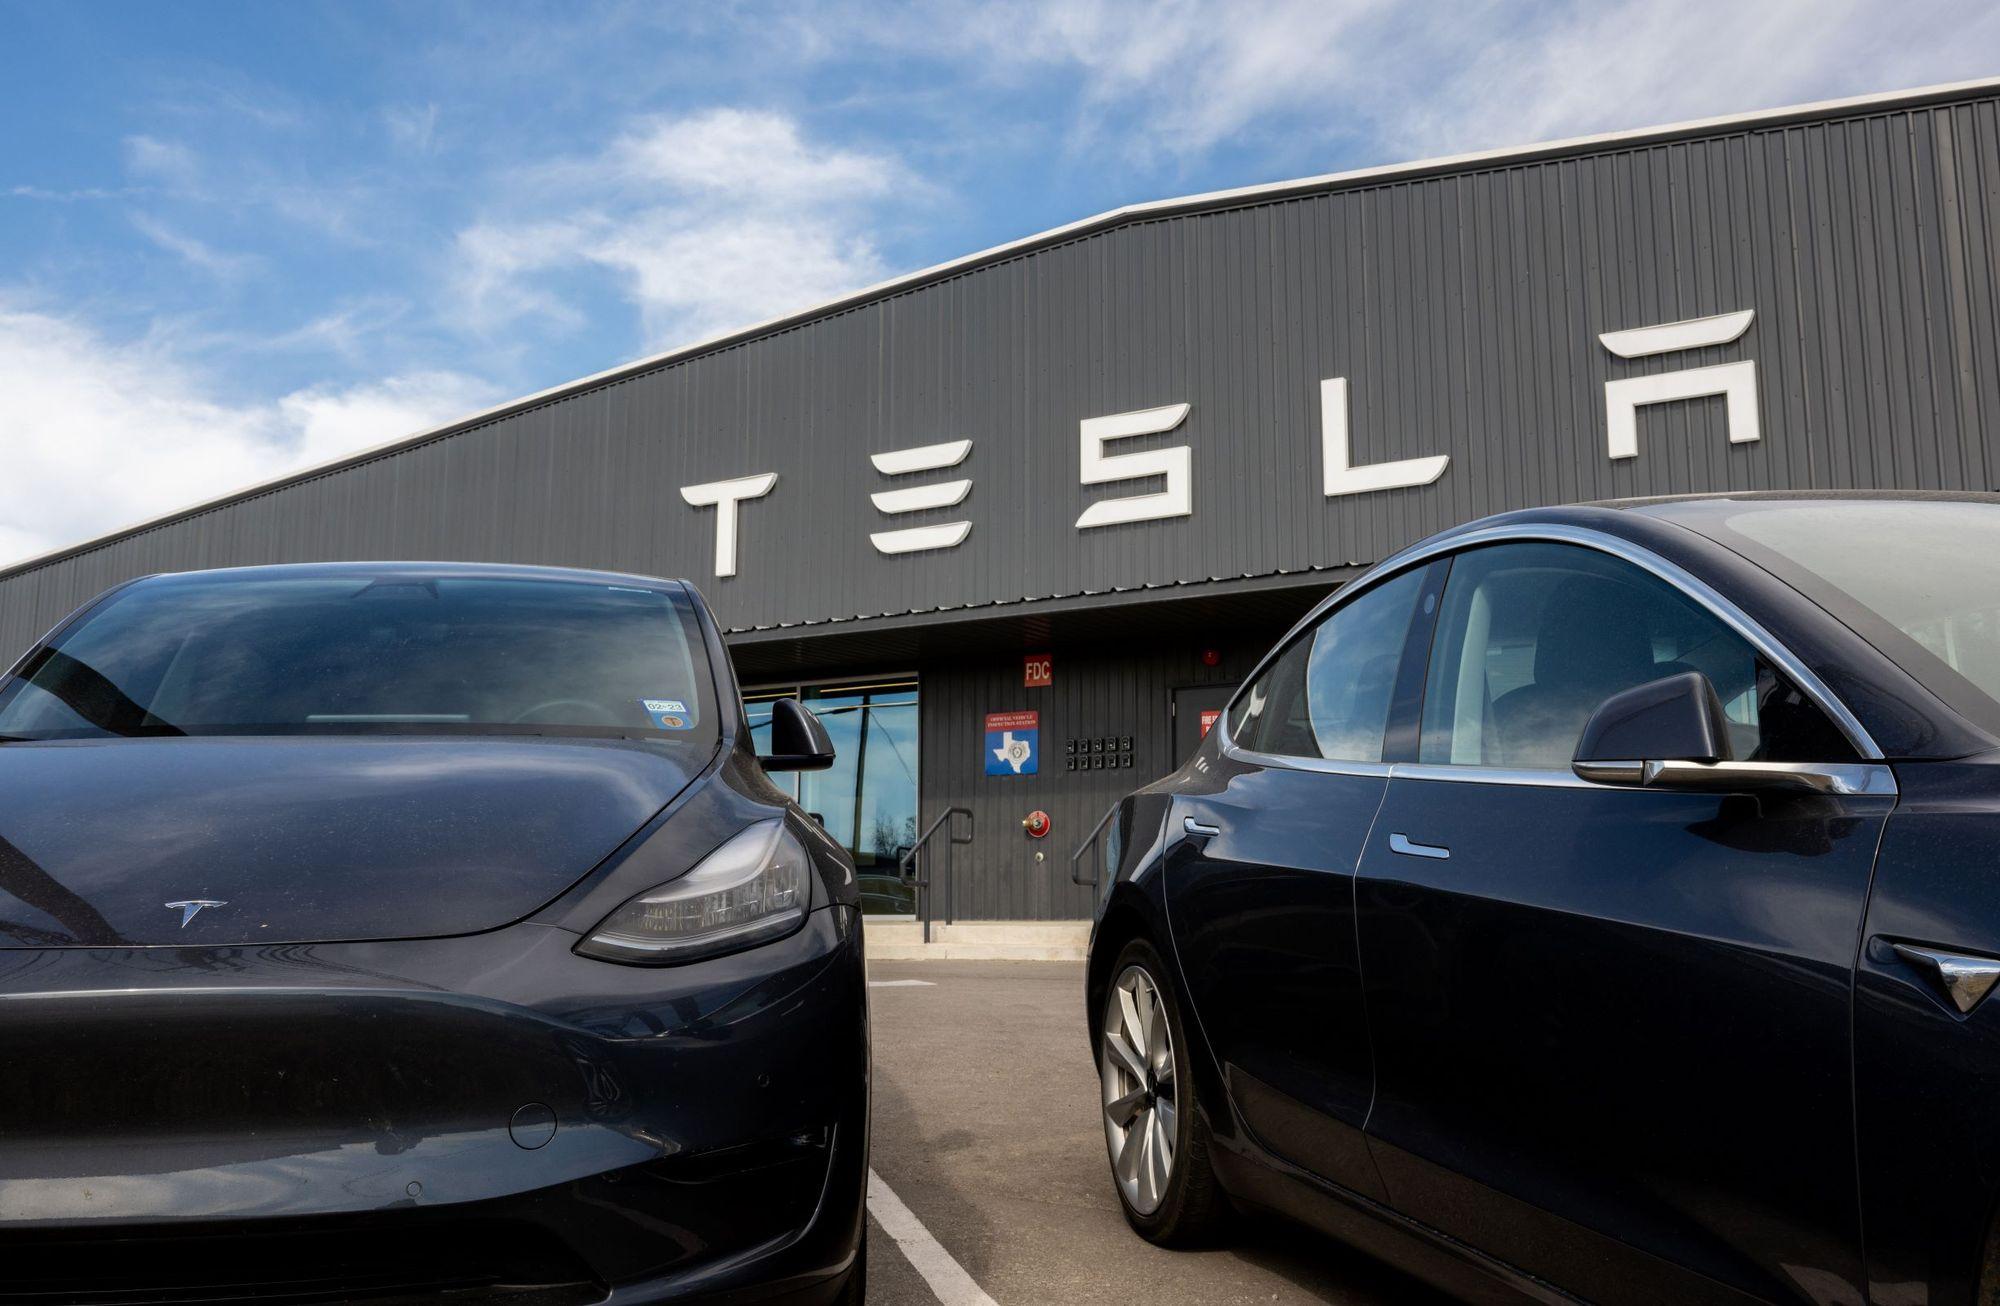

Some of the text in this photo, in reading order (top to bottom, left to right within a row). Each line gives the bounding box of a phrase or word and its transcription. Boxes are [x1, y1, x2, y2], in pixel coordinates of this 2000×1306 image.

[680, 308, 1761, 578] TESLA
[1026, 661, 1050, 681] FDC
[1201, 715, 1211, 725] FIRE
